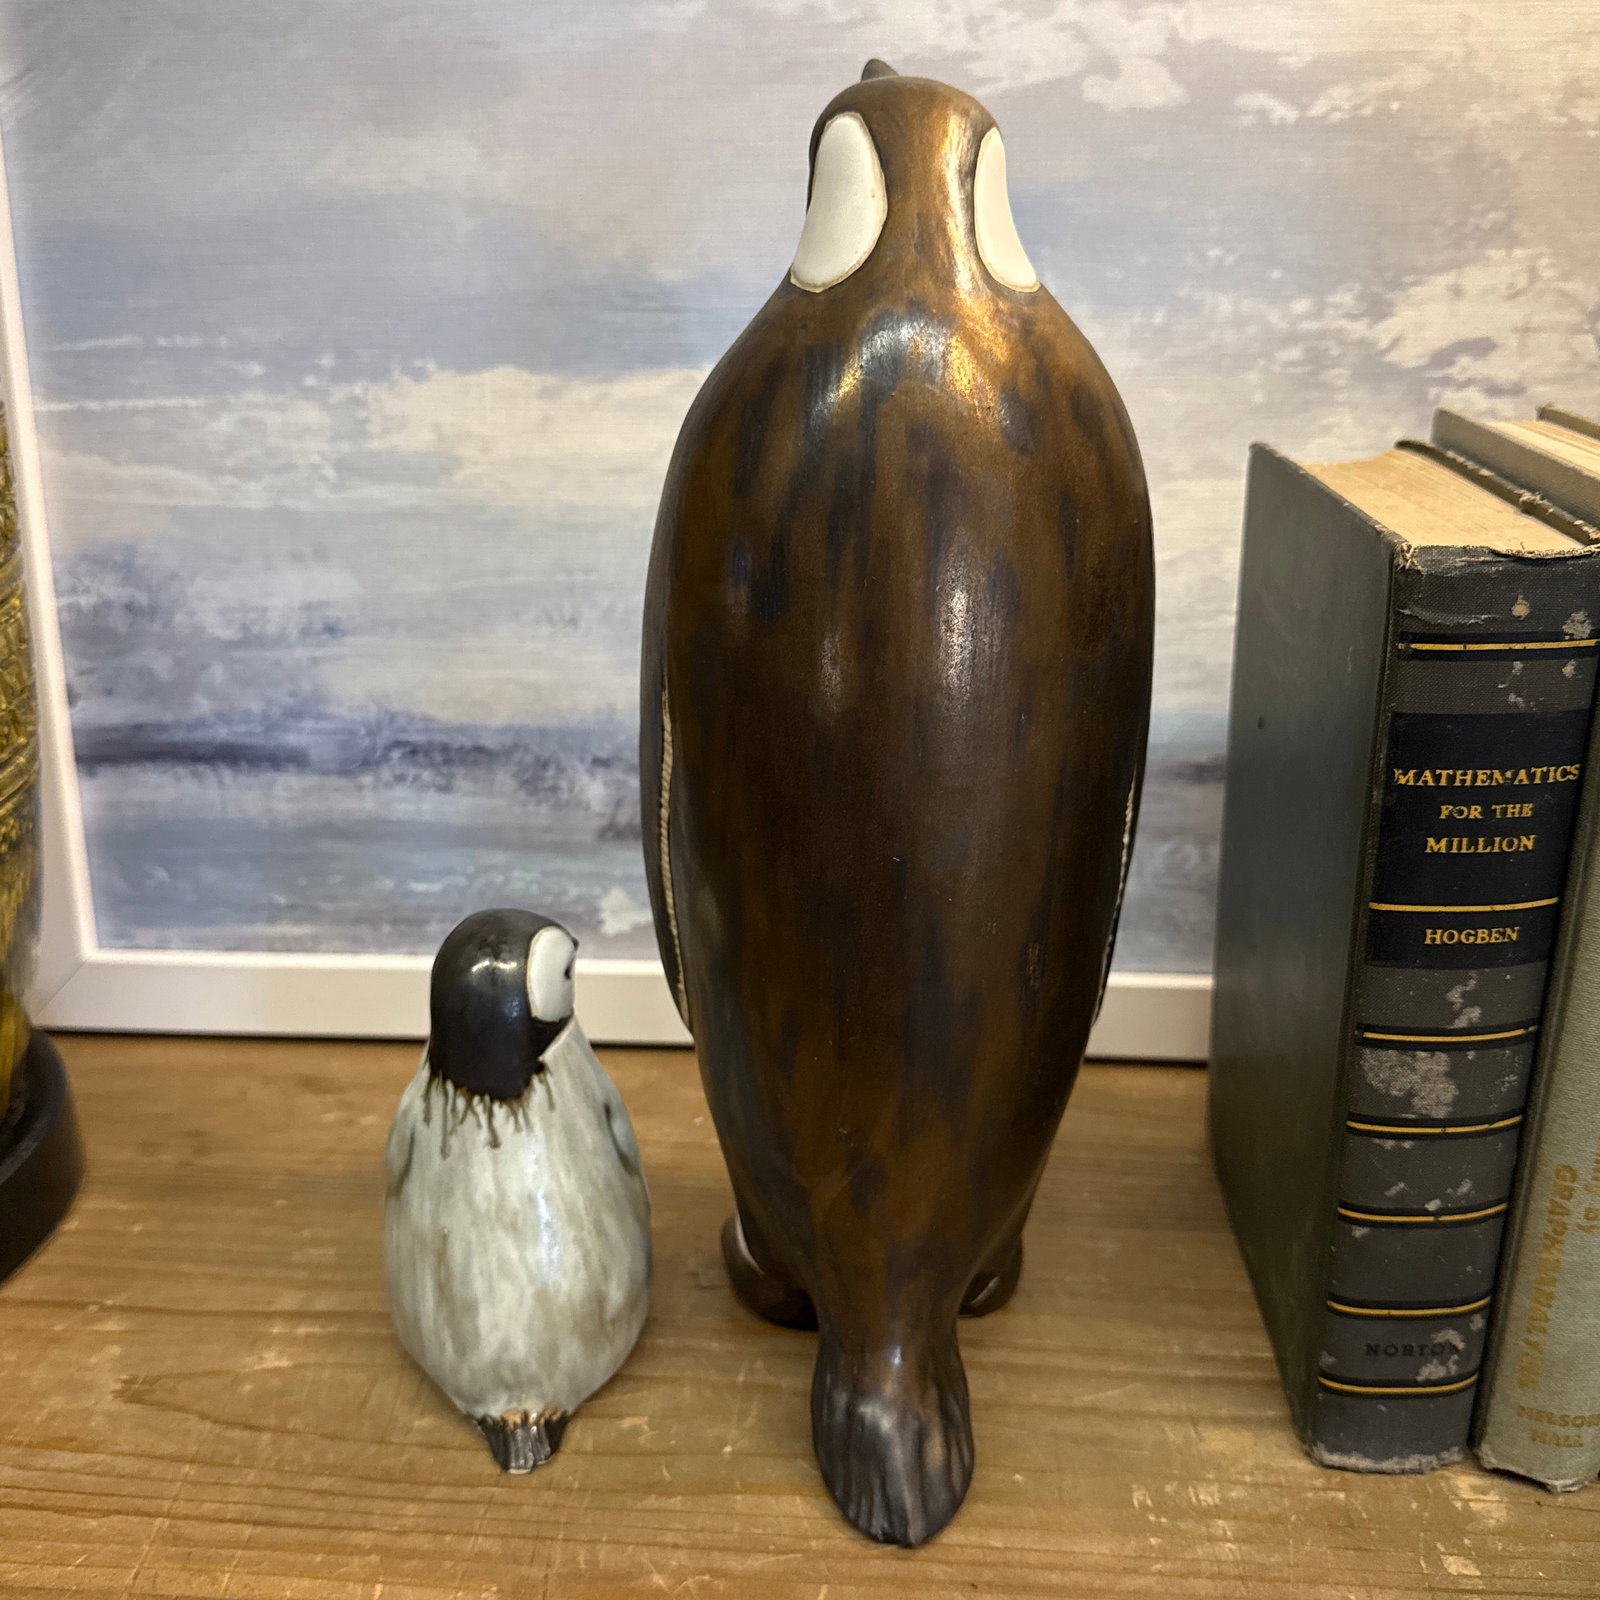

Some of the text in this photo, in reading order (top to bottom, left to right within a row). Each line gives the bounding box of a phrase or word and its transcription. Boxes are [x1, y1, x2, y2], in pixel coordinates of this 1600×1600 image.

[1394, 765, 1580, 786] MATHEMATICS
[1439, 803, 1533, 819] FOR THE
[1425, 835, 1536, 853] MILLION
[1424, 927, 1520, 944] HOGBEN
